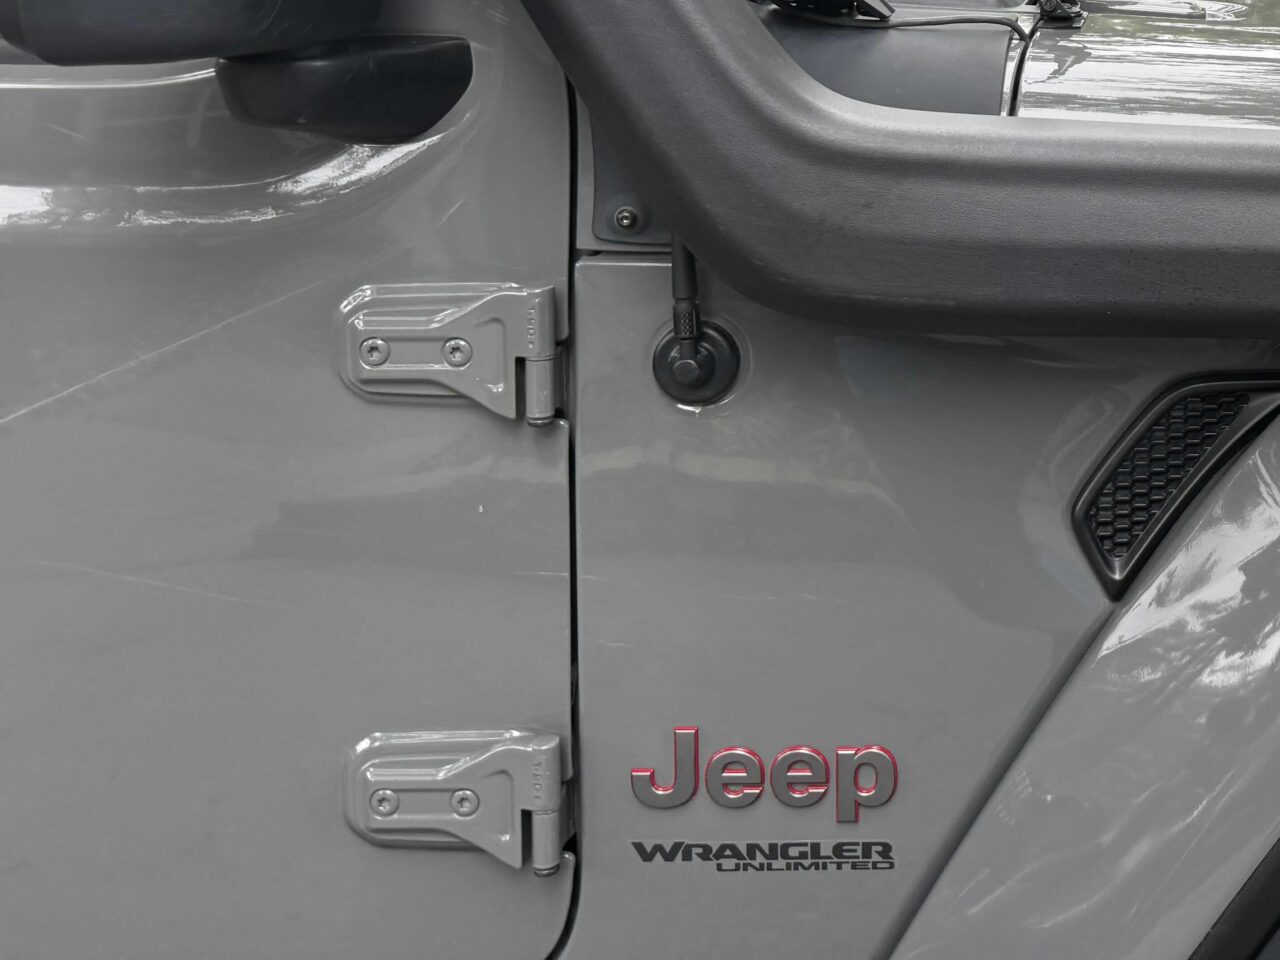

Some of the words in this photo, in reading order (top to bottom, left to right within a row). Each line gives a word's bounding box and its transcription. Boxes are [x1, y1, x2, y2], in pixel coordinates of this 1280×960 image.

[631, 726, 899, 824] Jeep
[631, 841, 895, 862] WRANGLER
[716, 861, 895, 872] UNLIMITED
